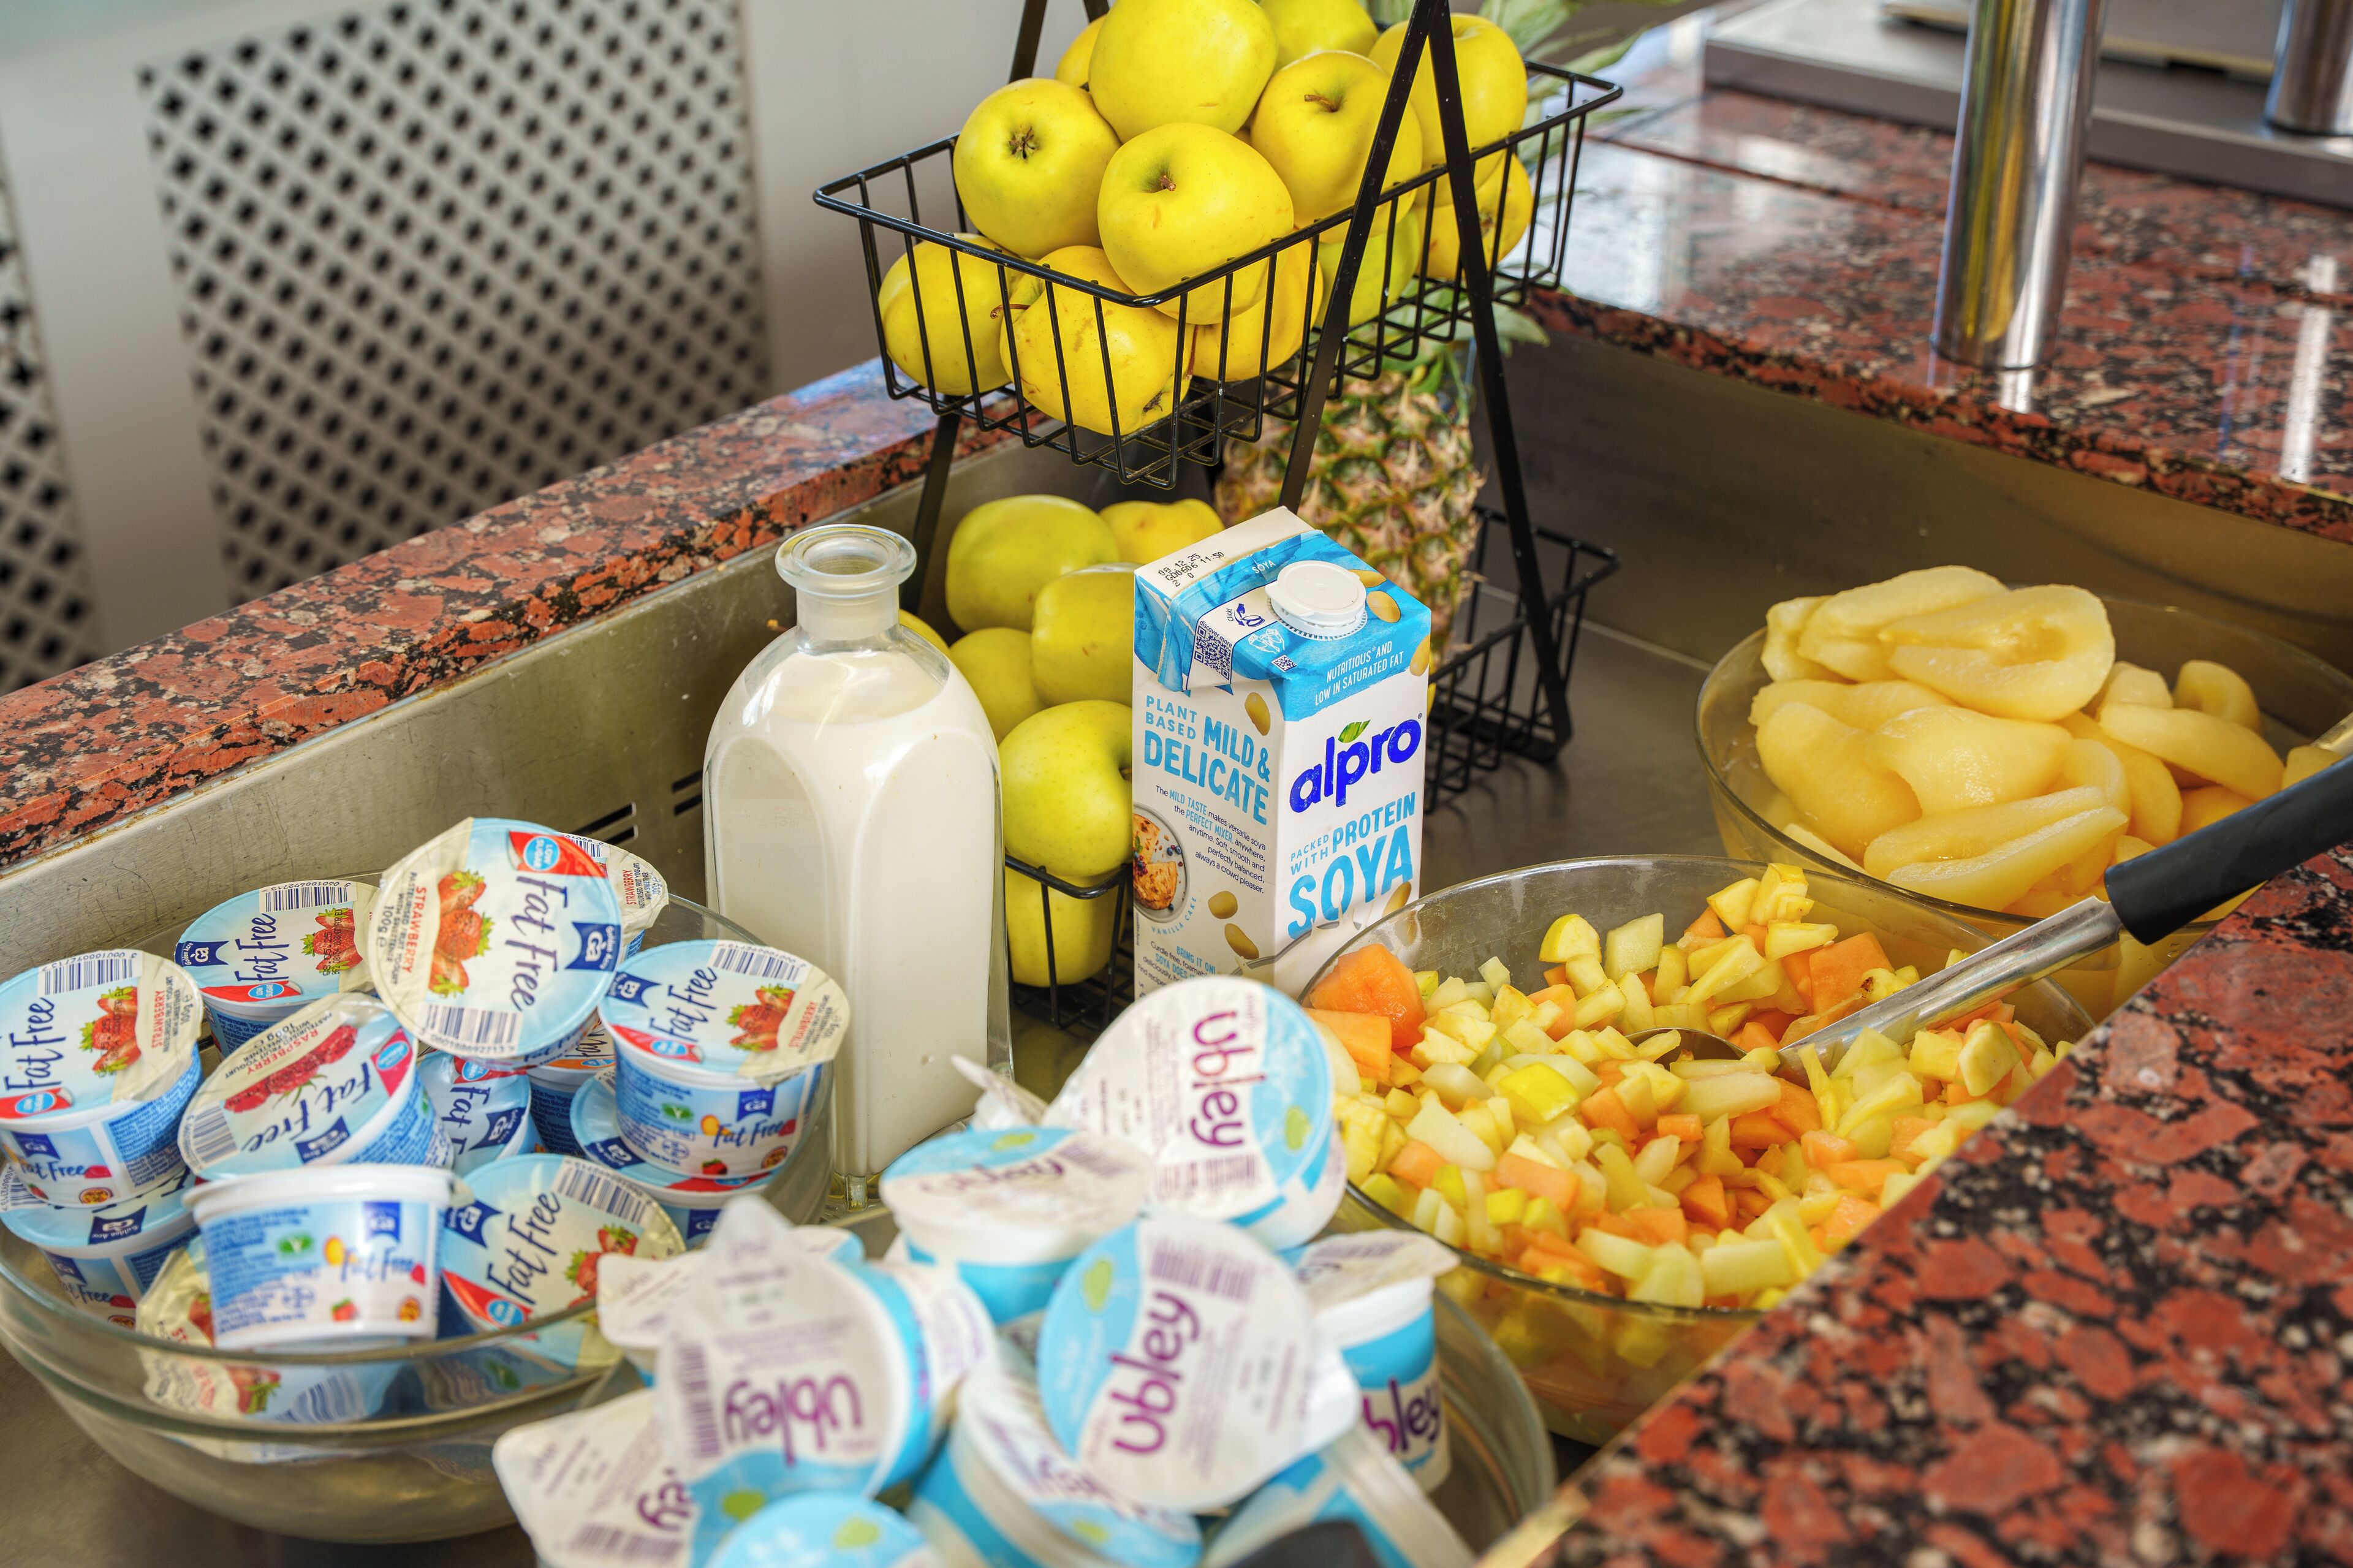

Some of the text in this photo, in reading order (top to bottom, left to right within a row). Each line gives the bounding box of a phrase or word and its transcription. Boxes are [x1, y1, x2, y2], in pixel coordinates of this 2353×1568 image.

[1200, 551, 1225, 564] 11:50
[1251, 559, 1276, 574] SOYA
[1226, 608, 1234, 622] Click!
[1199, 620, 1233, 648] discover more
[1376, 640, 1392, 659] AND
[1314, 651, 1404, 706] LOW IN SATURATED FAT
[1145, 711, 1197, 740] BASED
[1146, 695, 1197, 724] PLANT
[1203, 715, 1270, 783] MILD &
[1289, 719, 1422, 814] alpro
[1143, 729, 1269, 826] DELICATE
[1156, 785, 1266, 851] The MILD TASTE makes versatile soya
[1174, 805, 1185, 816] the
[1185, 809, 1213, 831] PERFECT
[1235, 838, 1265, 862] anywhere,
[1290, 791, 1415, 876] WITH PROTEIN
[534, 839, 544, 869] SUGAR
[545, 844, 554, 865] LOW
[1189, 824, 1265, 873] anytime. Soft, smooth and
[1207, 846, 1265, 884] perfectly balanced,
[1290, 834, 1329, 862] PACKED
[623, 869, 637, 906] STRAWBERRY
[1195, 851, 1216, 868] always
[1221, 866, 1239, 881] crowd
[1239, 877, 1264, 894] pleaser.
[1287, 824, 1413, 941] SOYA
[403, 871, 418, 926] PASTEURISED
[1151, 922, 1184, 935] VANILLA
[1184, 896, 1197, 921] CAKE
[235, 913, 290, 950] Free
[377, 905, 394, 935] 100g
[401, 885, 427, 975] STRAWBERRY
[183, 941, 194, 966] Golden Acre
[505, 876, 568, 1012] Fat Free
[1150, 941, 1169, 956] Curdle
[1169, 952, 1181, 966] free,
[1176, 945, 1216, 974] BRING IT ON!
[233, 951, 290, 982] Fat
[1137, 963, 1148, 975] Find
[1142, 956, 1173, 980] deliciously,
[1155, 953, 1170, 969] SOYA
[1172, 963, 1188, 979] DOES
[254, 987, 263, 997] LOW
[265, 983, 274, 998] SUGAR
[666, 967, 718, 1010] Free
[151, 990, 165, 1050] STRAWBERRY
[181, 1004, 194, 1026] 100g
[284, 1013, 333, 1044] PASTEURISED
[289, 1020, 311, 1035] WITH
[648, 1006, 708, 1043] Fat
[789, 1000, 819, 1050] STRAWBERRY
[4, 997, 67, 1091] Fat Free
[246, 1029, 320, 1075] RASPBERRY
[261, 1045, 282, 1059] FRUIT
[224, 1053, 261, 1079] YOGURT
[1189, 1009, 1267, 1150] Ubley
[314, 1061, 373, 1114] Fat
[241, 1099, 311, 1153] Free
[441, 1086, 491, 1129] Fat
[713, 1119, 784, 1149] Fat Free
[46, 1161, 86, 1182] Free
[486, 1192, 562, 1305] Fat Free
[77, 1284, 112, 1304] Free
[1108, 1290, 1201, 1456] Ubley
[723, 1374, 863, 1468] Ubley
